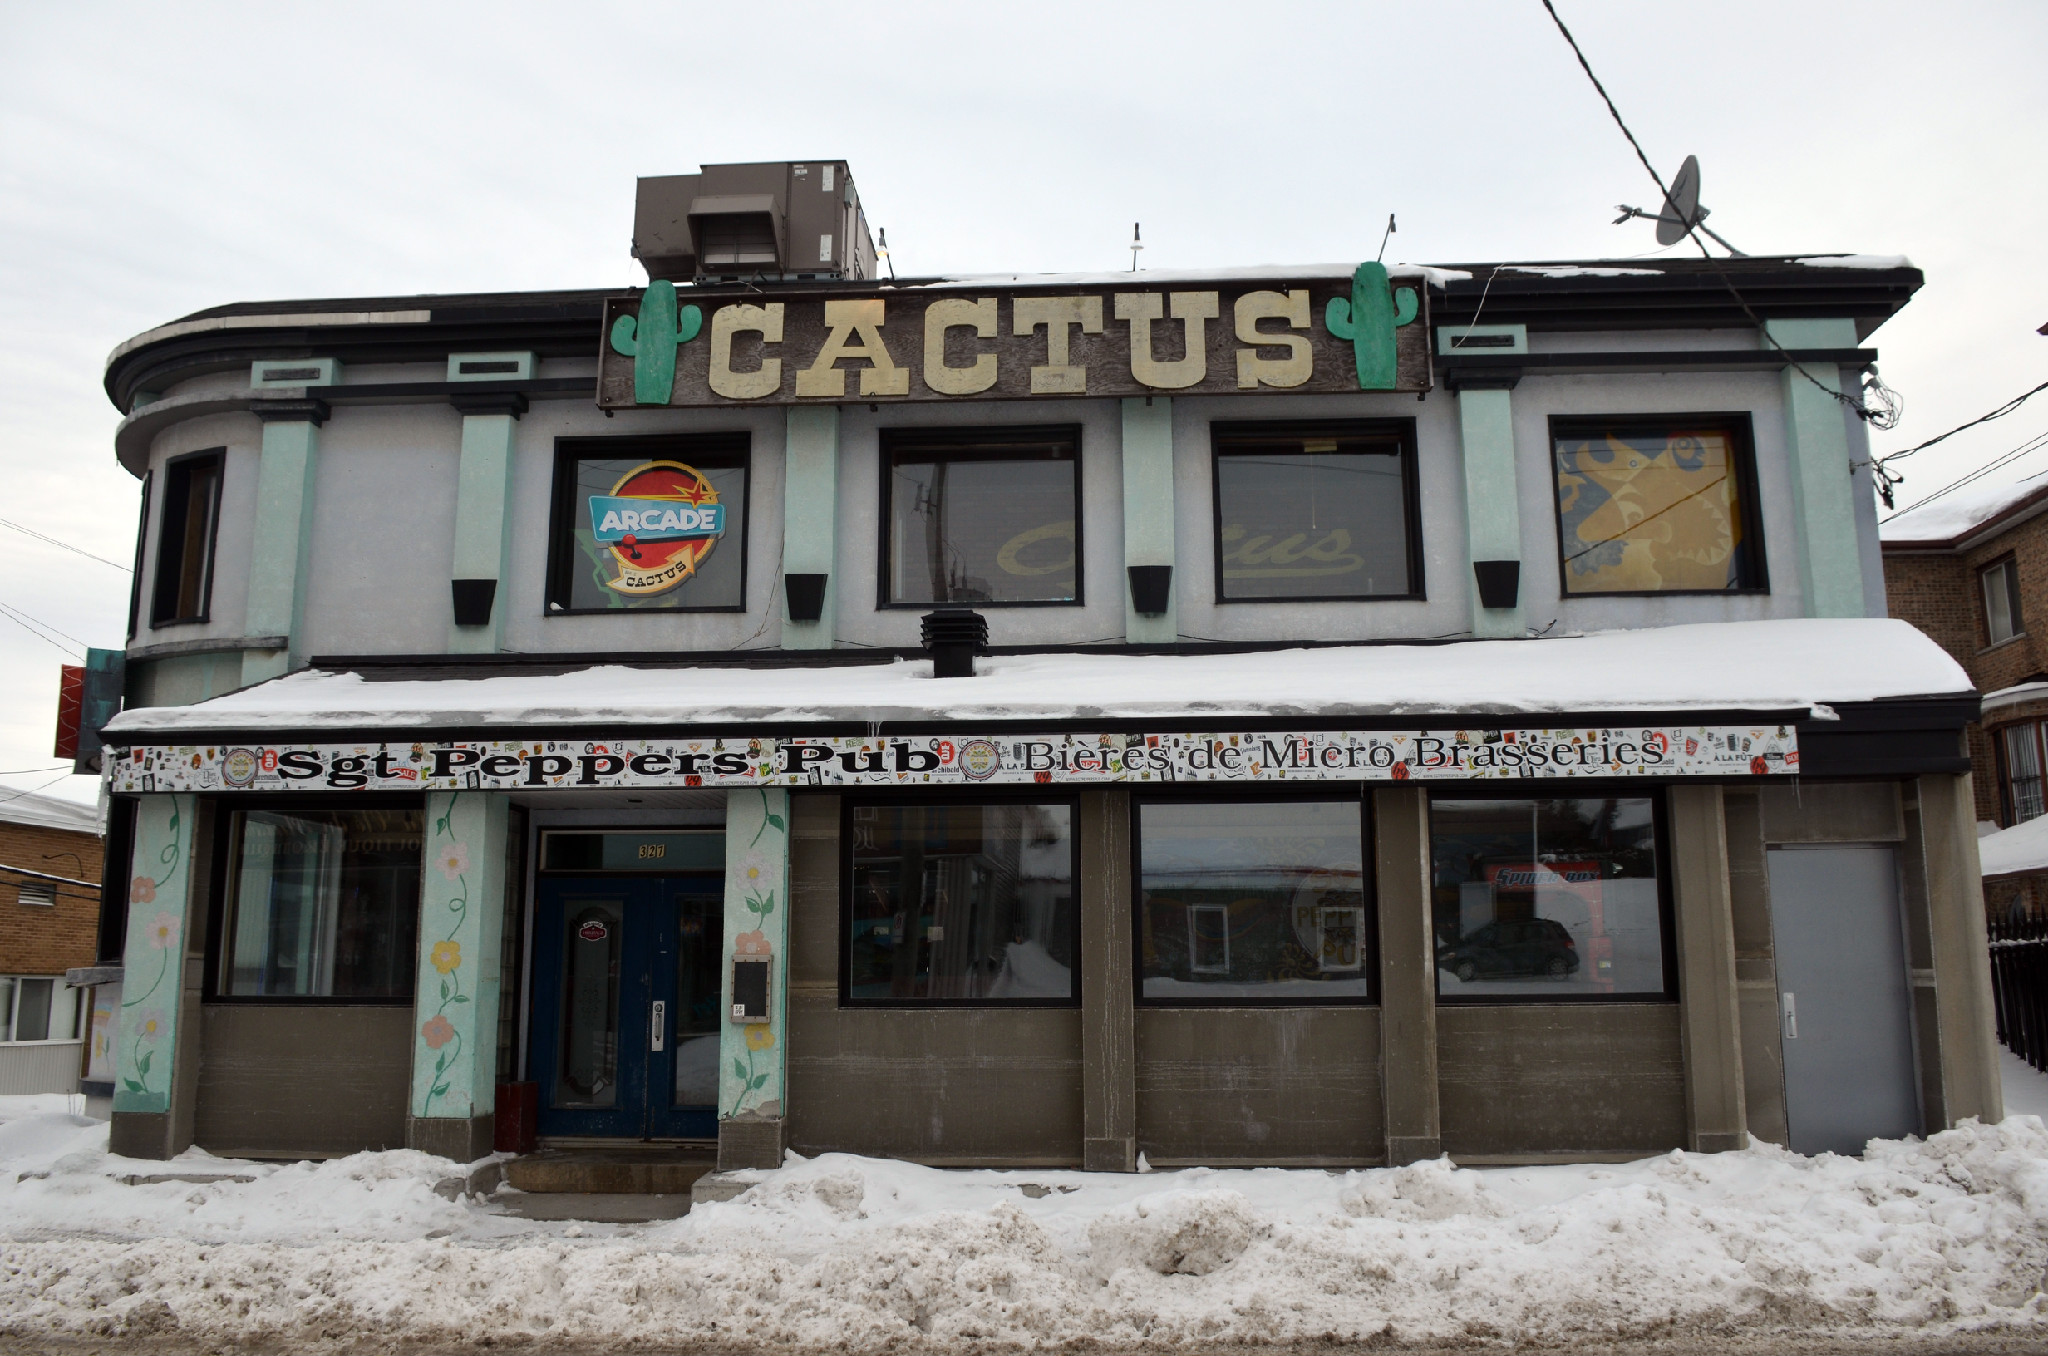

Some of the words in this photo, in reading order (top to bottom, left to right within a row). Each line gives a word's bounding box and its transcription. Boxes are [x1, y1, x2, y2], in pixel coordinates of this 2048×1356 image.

[708, 287, 1314, 400] CACTUS
[599, 508, 717, 533] ARCADE
[625, 560, 688, 588] CACTUS
[277, 750, 401, 788] Sgt
[428, 749, 750, 786] Peppers
[780, 742, 941, 774] Pub
[1021, 739, 1171, 772] Bières
[1188, 739, 1242, 770] de
[1258, 739, 1395, 769] Micro
[1412, 736, 1664, 768] Brasseries
[639, 845, 665, 858] 327
